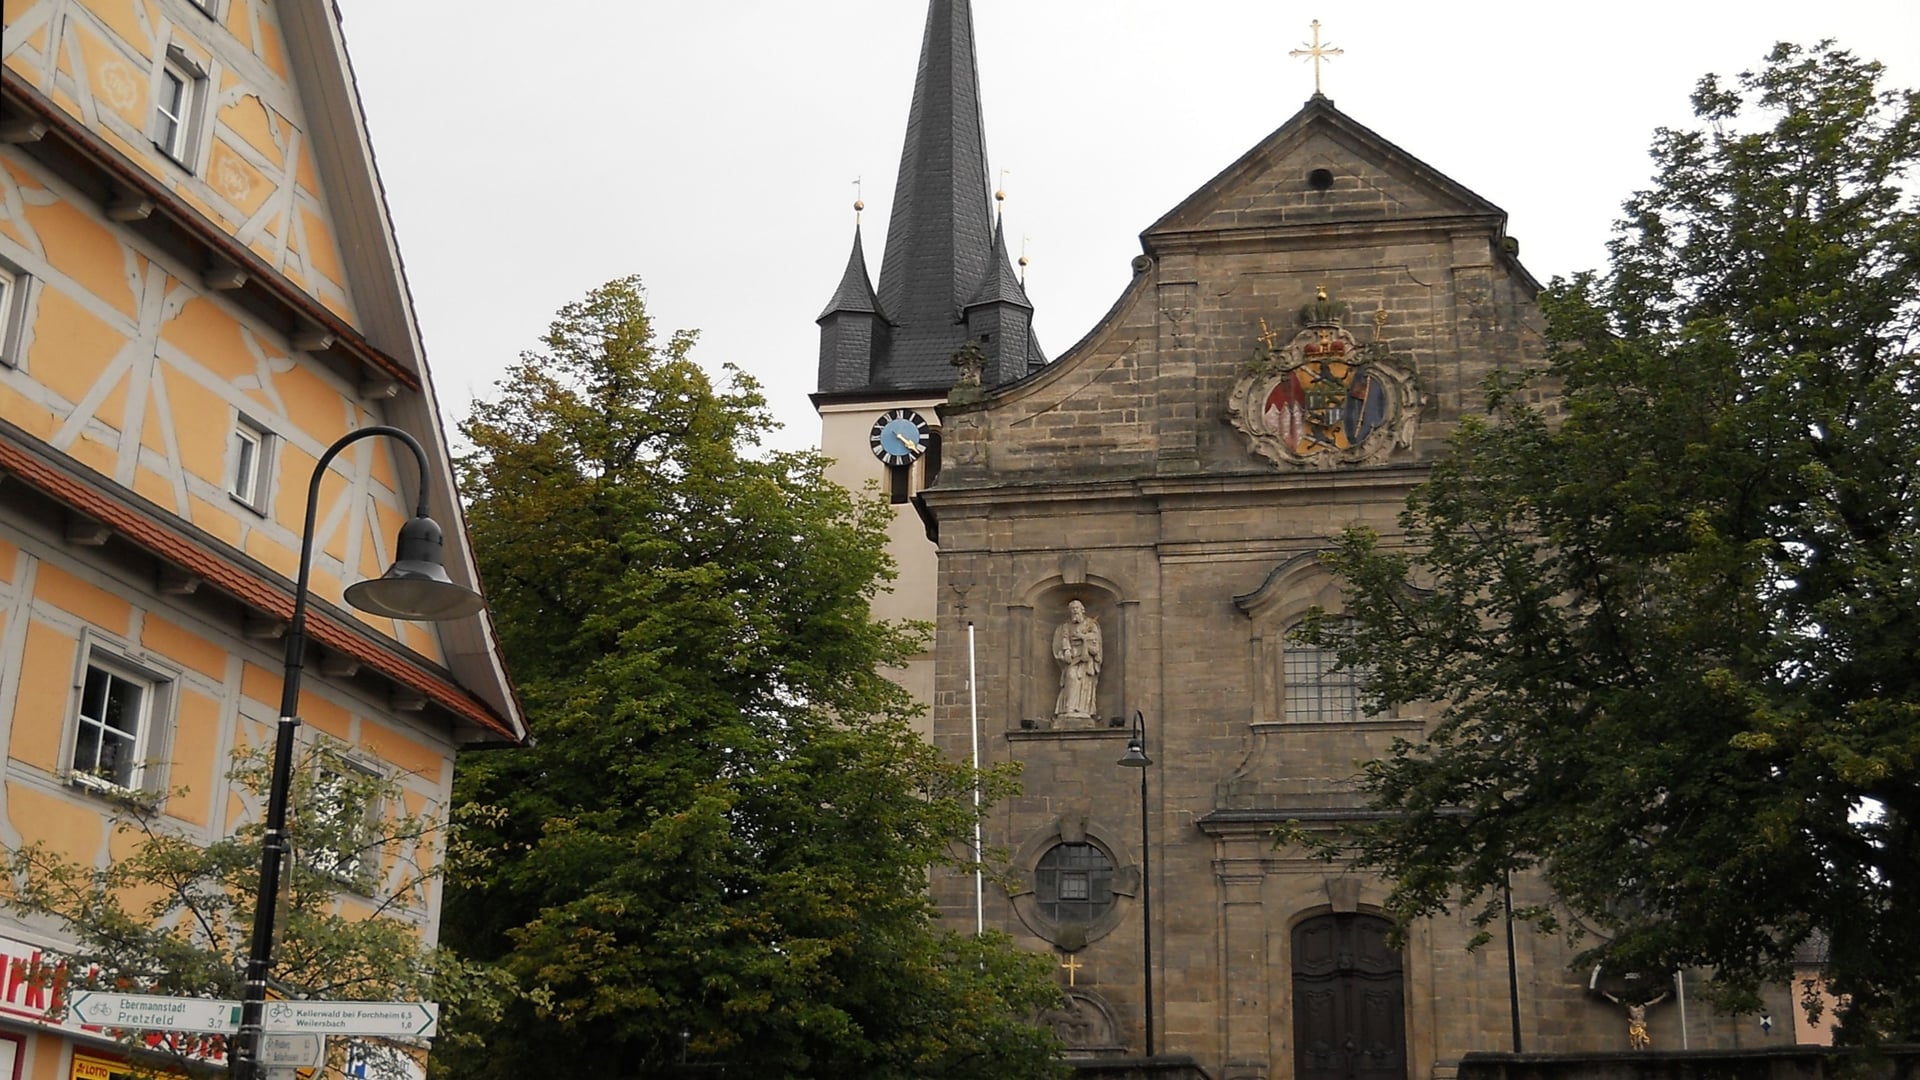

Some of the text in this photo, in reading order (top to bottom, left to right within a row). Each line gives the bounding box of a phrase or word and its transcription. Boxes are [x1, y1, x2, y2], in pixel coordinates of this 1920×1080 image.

[119, 999, 225, 1016] Ebermannstadt 7
[296, 1009, 341, 1018] Kellerwald
[342, 1010, 355, 1018] bei
[357, 1010, 400, 1019] Forchheim
[118, 1012, 175, 1026] Pretzfeld
[296, 1019, 346, 1028] Weilersbach
[86, 1064, 107, 1078] LOTTO
